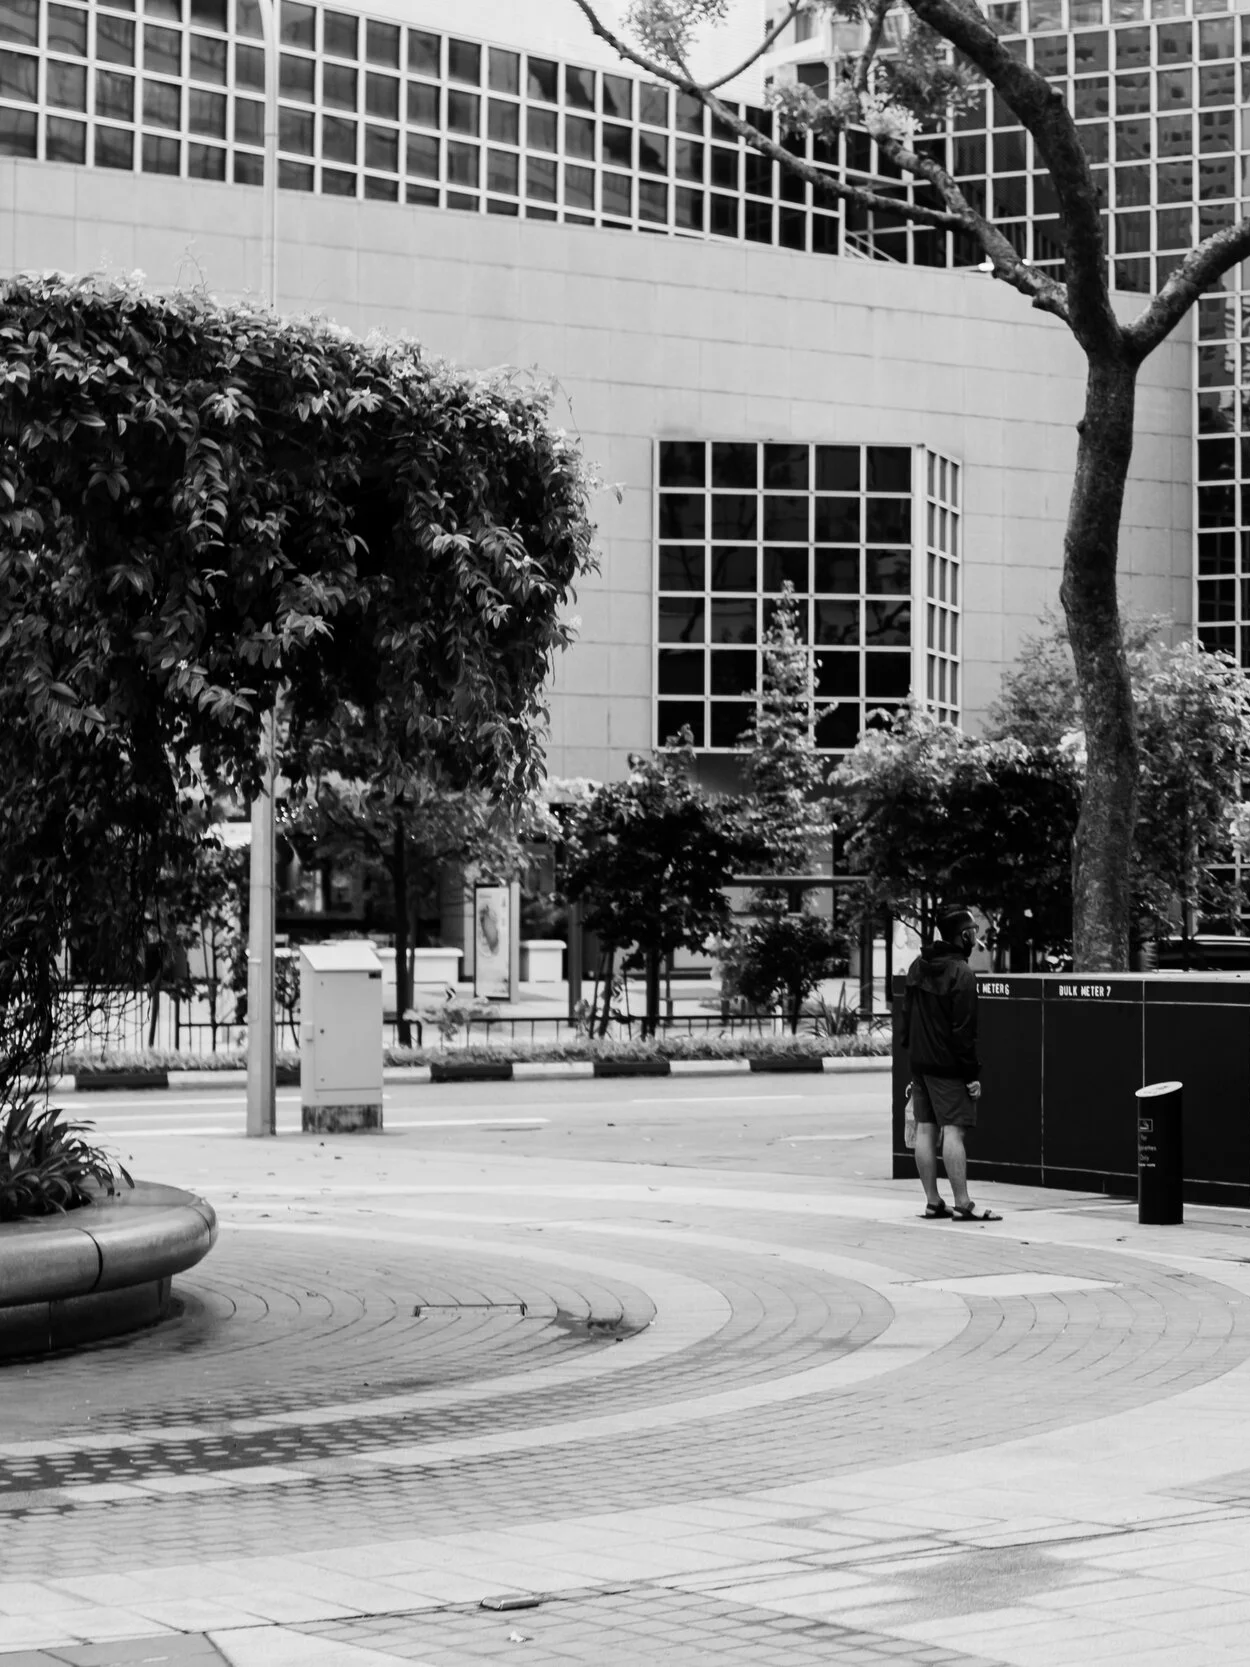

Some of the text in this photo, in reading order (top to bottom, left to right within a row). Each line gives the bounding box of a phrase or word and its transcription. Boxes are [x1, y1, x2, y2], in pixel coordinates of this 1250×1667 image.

[1059, 984, 1112, 998] BULK METER 7
